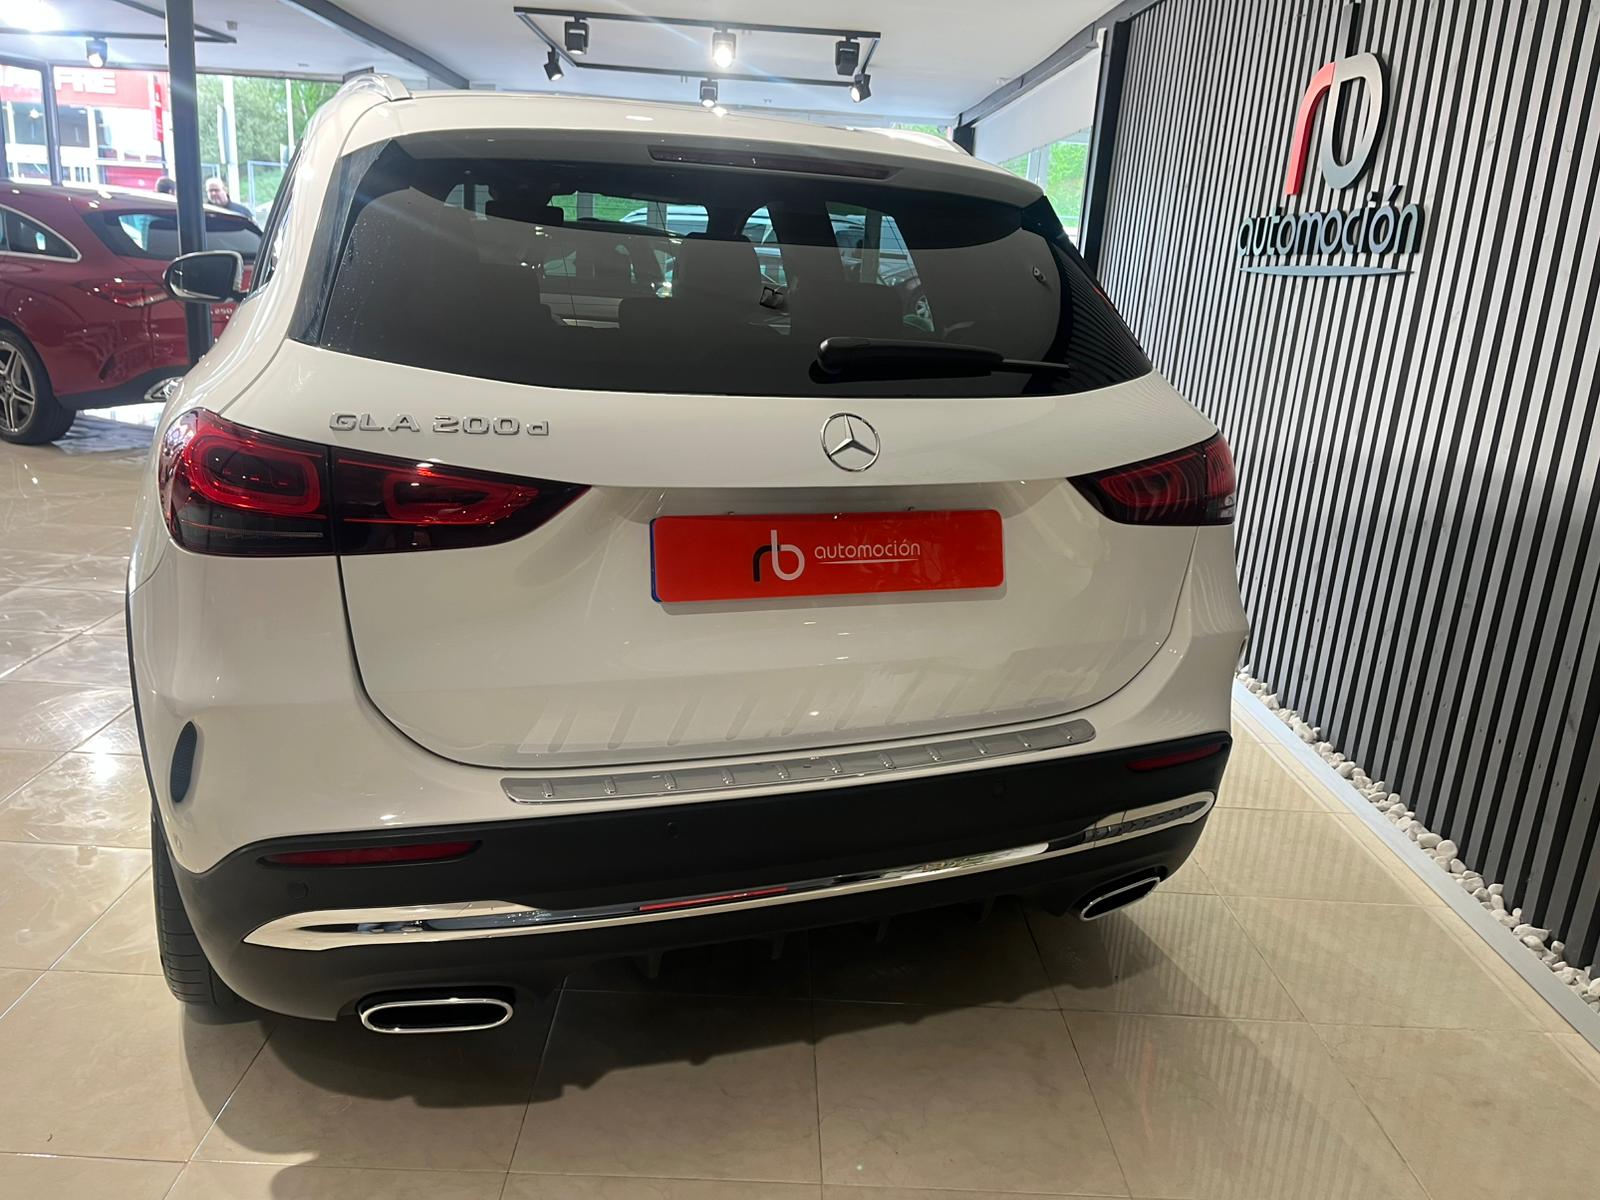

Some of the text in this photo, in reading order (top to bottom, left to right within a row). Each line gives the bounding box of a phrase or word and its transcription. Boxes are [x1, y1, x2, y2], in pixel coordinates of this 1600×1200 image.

[1285, 5, 1385, 195] rb
[1237, 184, 1423, 256] automoción
[329, 411, 421, 433] GLA
[752, 529, 921, 582] rb automoción
